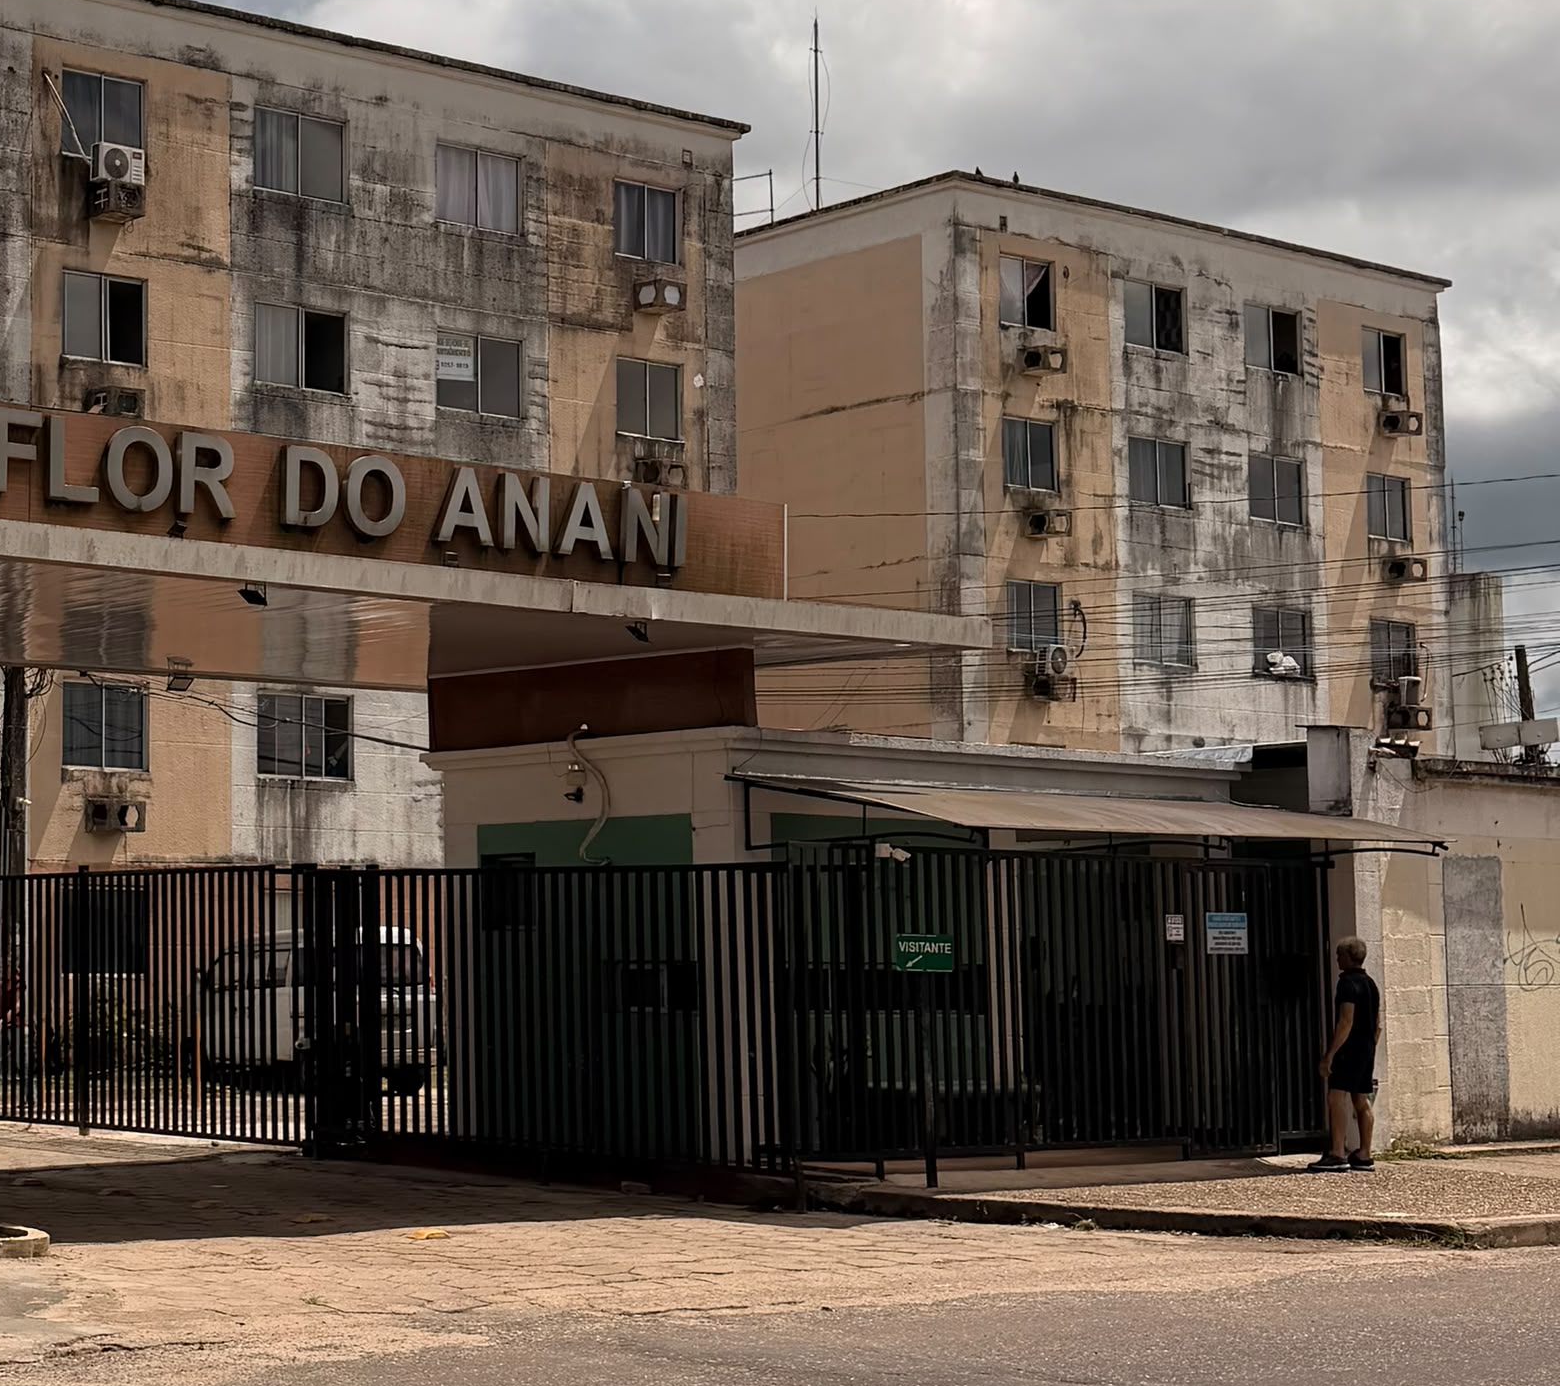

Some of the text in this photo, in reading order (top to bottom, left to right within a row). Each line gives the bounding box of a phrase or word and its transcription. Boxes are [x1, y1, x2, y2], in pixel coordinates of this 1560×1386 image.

[280, 444, 407, 538] DO
[438, 467, 687, 568] ANANI
[898, 941, 952, 954] VISITANTE
